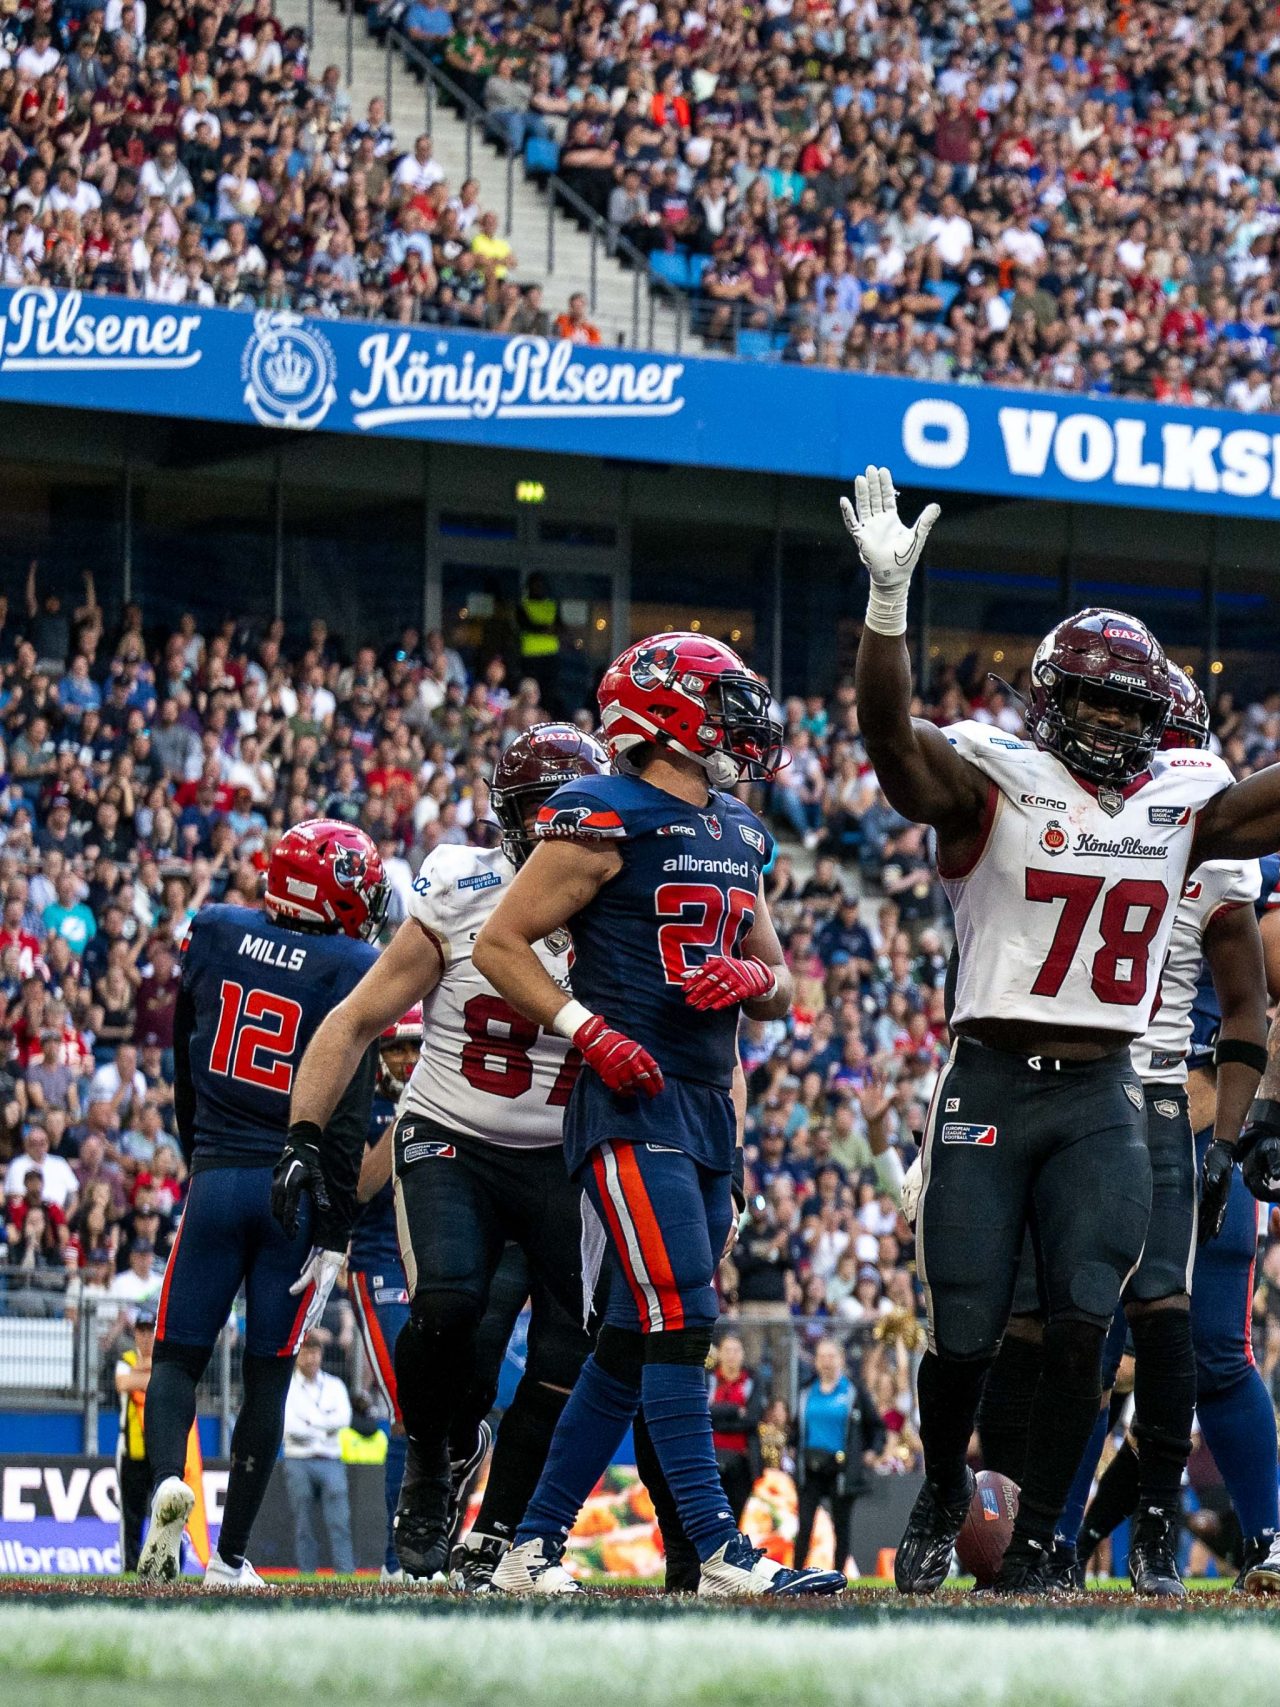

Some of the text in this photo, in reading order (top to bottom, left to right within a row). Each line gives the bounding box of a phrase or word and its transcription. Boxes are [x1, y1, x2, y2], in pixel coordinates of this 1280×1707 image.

[1109, 672, 1147, 687] FORELLE
[662, 854, 749, 878] allbranded
[237, 933, 307, 971] MILLS
[1025, 867, 1169, 1005] 78
[208, 979, 303, 1094] 12
